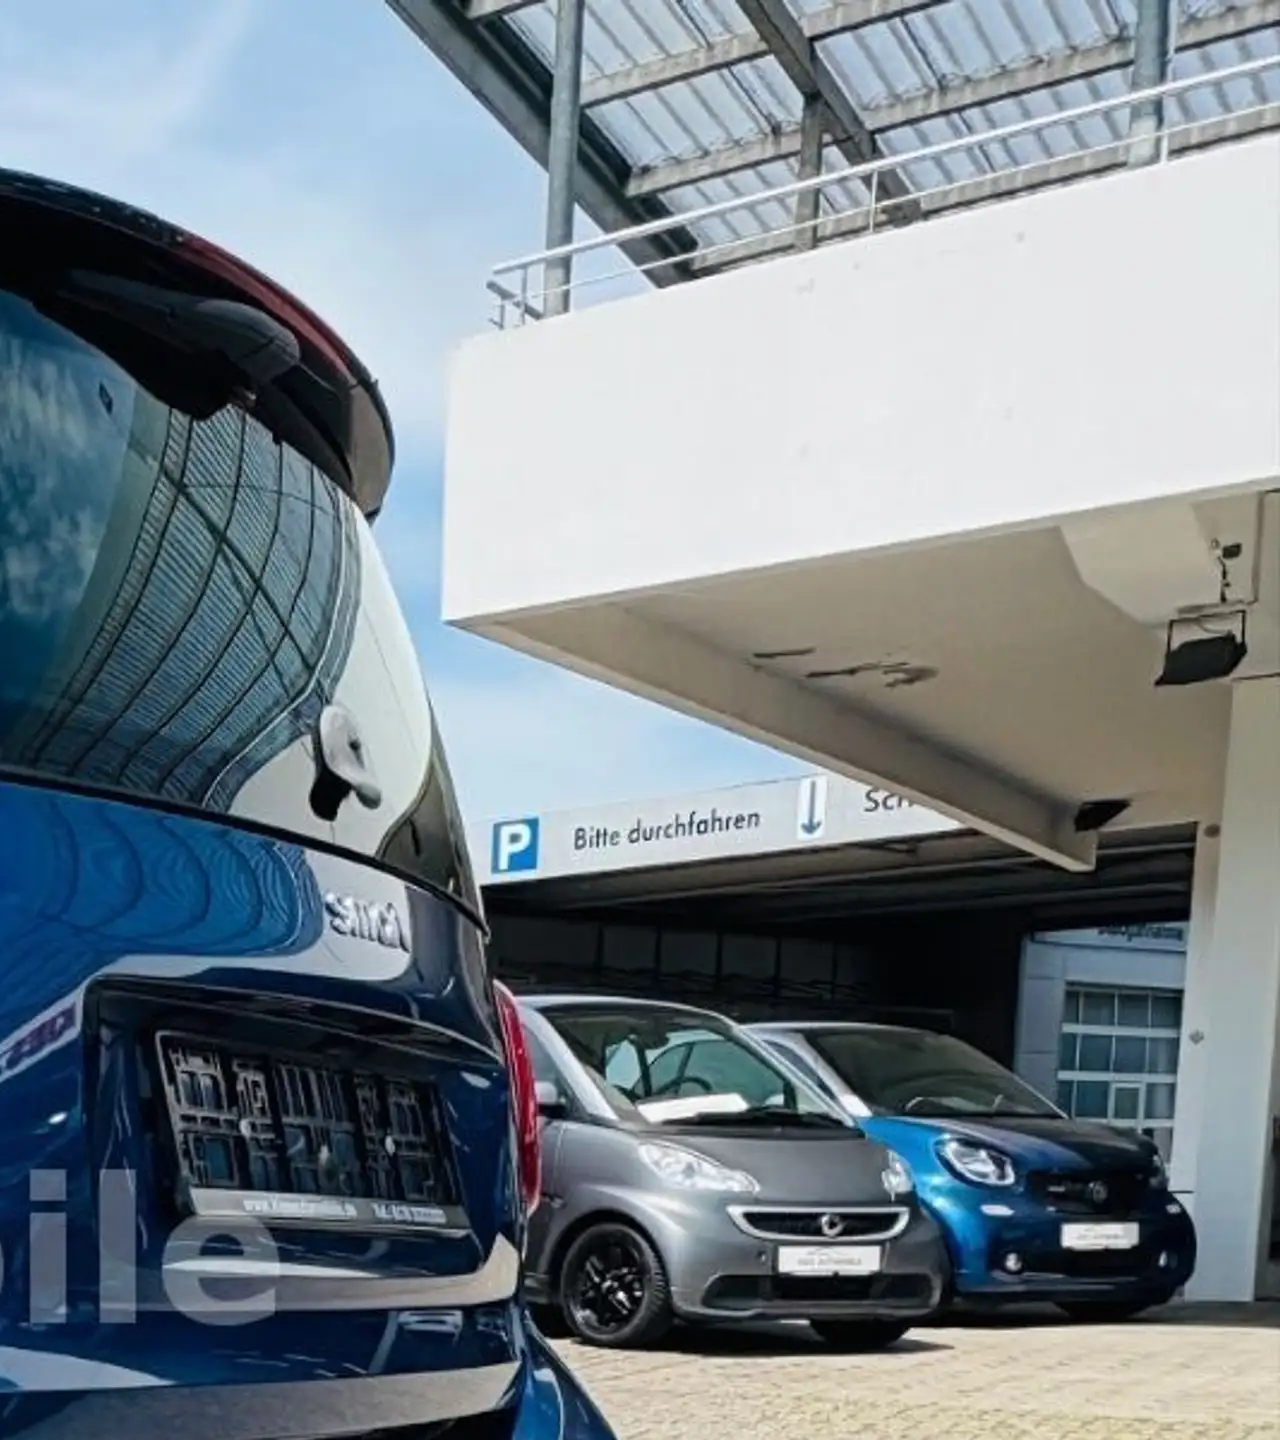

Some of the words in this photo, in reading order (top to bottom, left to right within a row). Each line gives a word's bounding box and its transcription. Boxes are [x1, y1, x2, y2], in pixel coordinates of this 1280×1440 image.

[497, 823, 532, 871] P
[573, 826, 621, 851] Bitte
[627, 808, 761, 845] durchfahren
